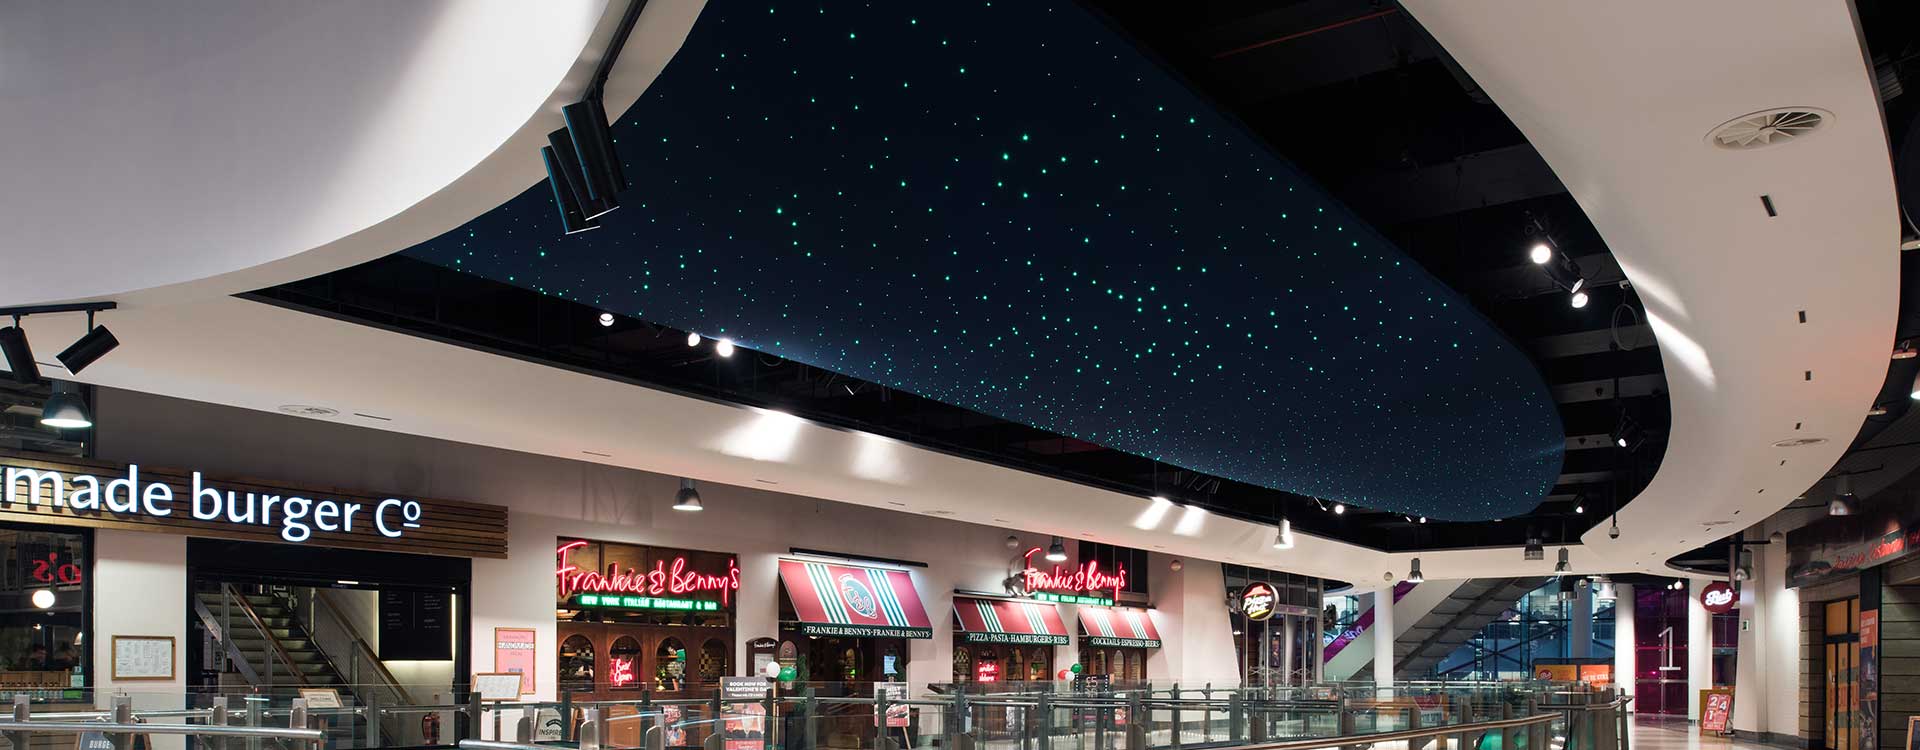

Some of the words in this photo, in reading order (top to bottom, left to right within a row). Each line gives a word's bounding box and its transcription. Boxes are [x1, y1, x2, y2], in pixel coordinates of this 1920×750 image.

[6, 464, 173, 516] made
[193, 471, 361, 542] burger
[556, 541, 645, 596] Frankie
[649, 560, 666, 595] &
[670, 557, 740, 608] Benny's
[1024, 547, 1073, 593] Frankie
[1075, 563, 1085, 592] &
[1086, 560, 1126, 602] Benny's
[601, 596, 620, 606] YORK
[623, 597, 650, 608] ITALIAN
[653, 598, 693, 610] RESTAURANT
[1243, 594, 1272, 611] Pizza
[1705, 588, 1733, 606] Rub
[806, 625, 839, 635] FRANKIE
[844, 627, 871, 637] BENNY'S
[873, 629, 900, 637] FRANKIE
[906, 630, 930, 638] BENNY'S
[969, 632, 989, 642] PIZZA
[991, 633, 1009, 643] PASTA
[1010, 634, 1053, 644] HAMBURGERS
[1053, 636, 1067, 644] RIBS
[1093, 637, 1120, 646] COCKTAILS
[1121, 638, 1143, 647] ESPRESSO
[1710, 696, 1718, 707] 2
[1719, 700, 1727, 711] 4
